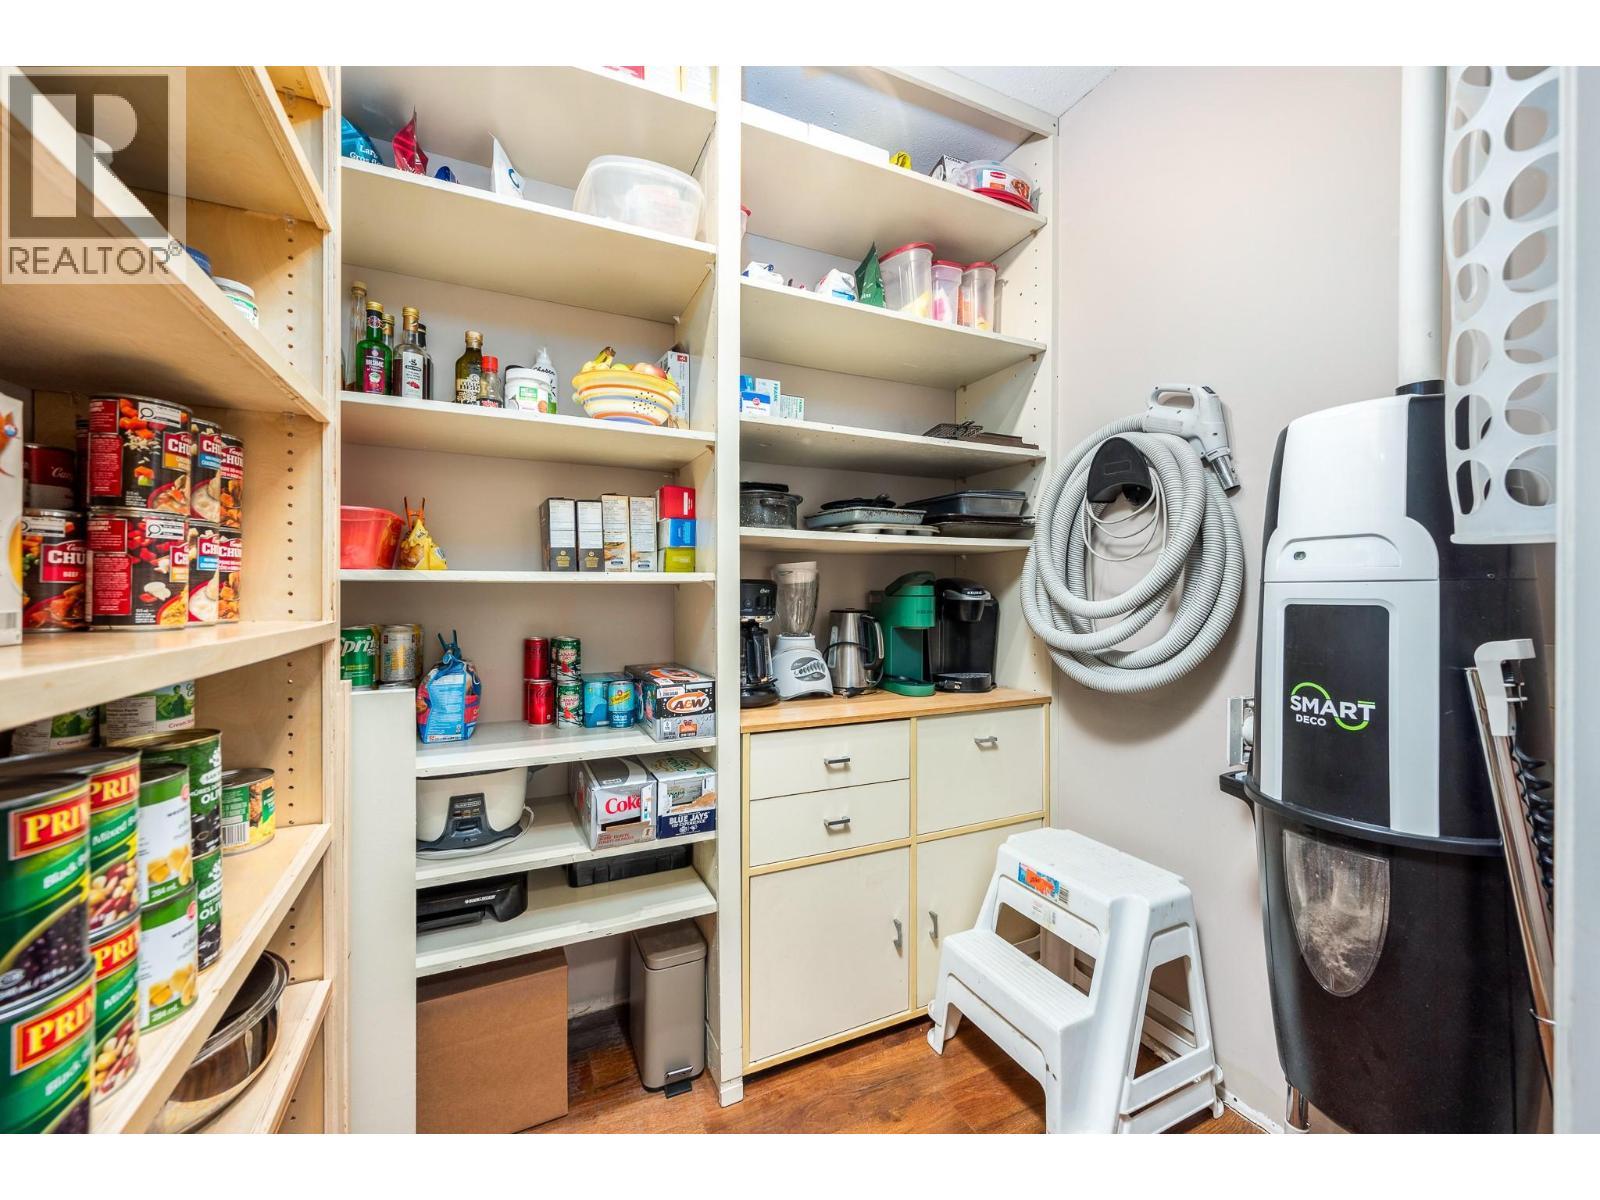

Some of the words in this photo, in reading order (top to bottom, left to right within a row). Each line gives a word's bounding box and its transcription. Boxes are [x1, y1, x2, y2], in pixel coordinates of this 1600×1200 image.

[1290, 695, 1376, 722] SMART
[1296, 714, 1327, 727] DECO
[669, 815, 689, 825] BLUE
[690, 812, 709, 820] JAYS
